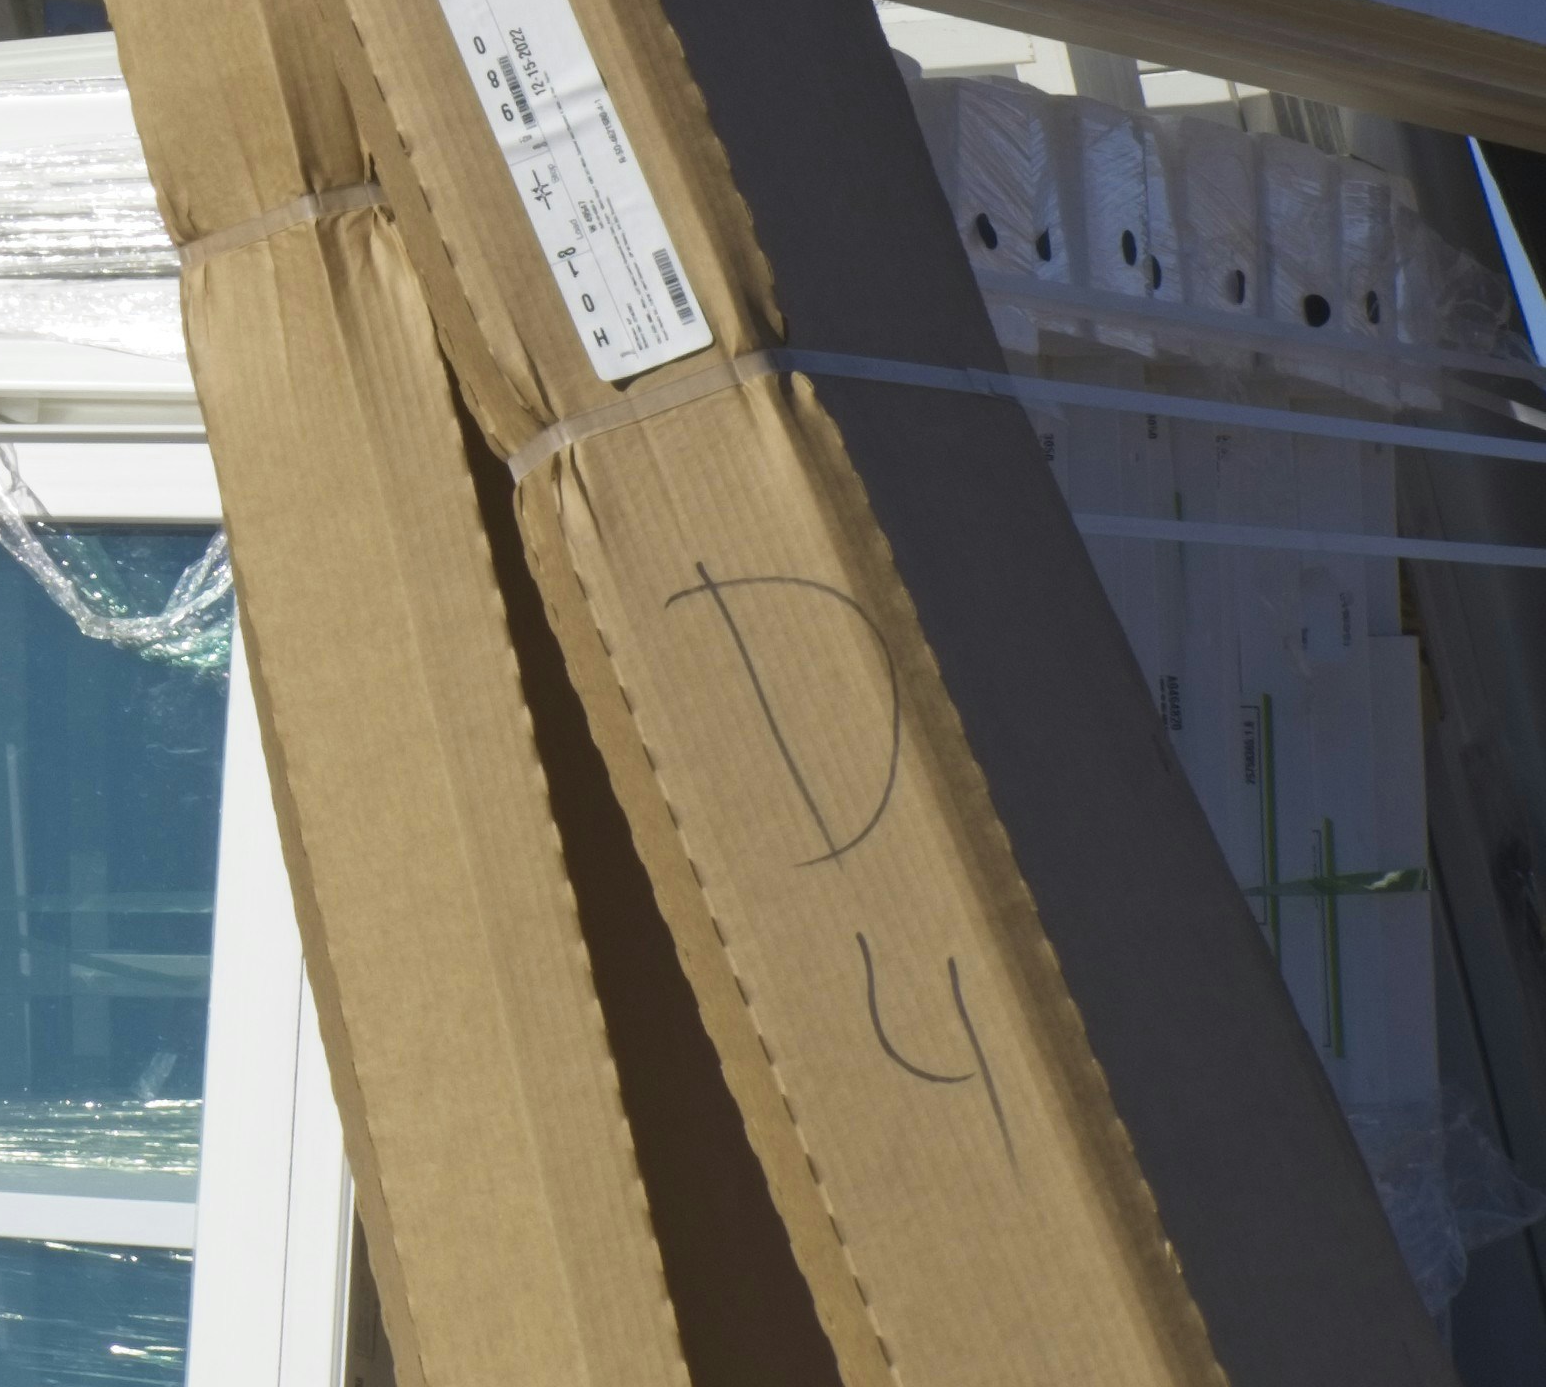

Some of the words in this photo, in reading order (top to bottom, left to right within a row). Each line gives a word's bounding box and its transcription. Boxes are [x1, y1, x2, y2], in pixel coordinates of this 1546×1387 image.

[509, 26, 546, 97] 12-15-2022
[570, 218, 583, 240] Load
[593, 327, 611, 349] H
[663, 561, 902, 872] D
